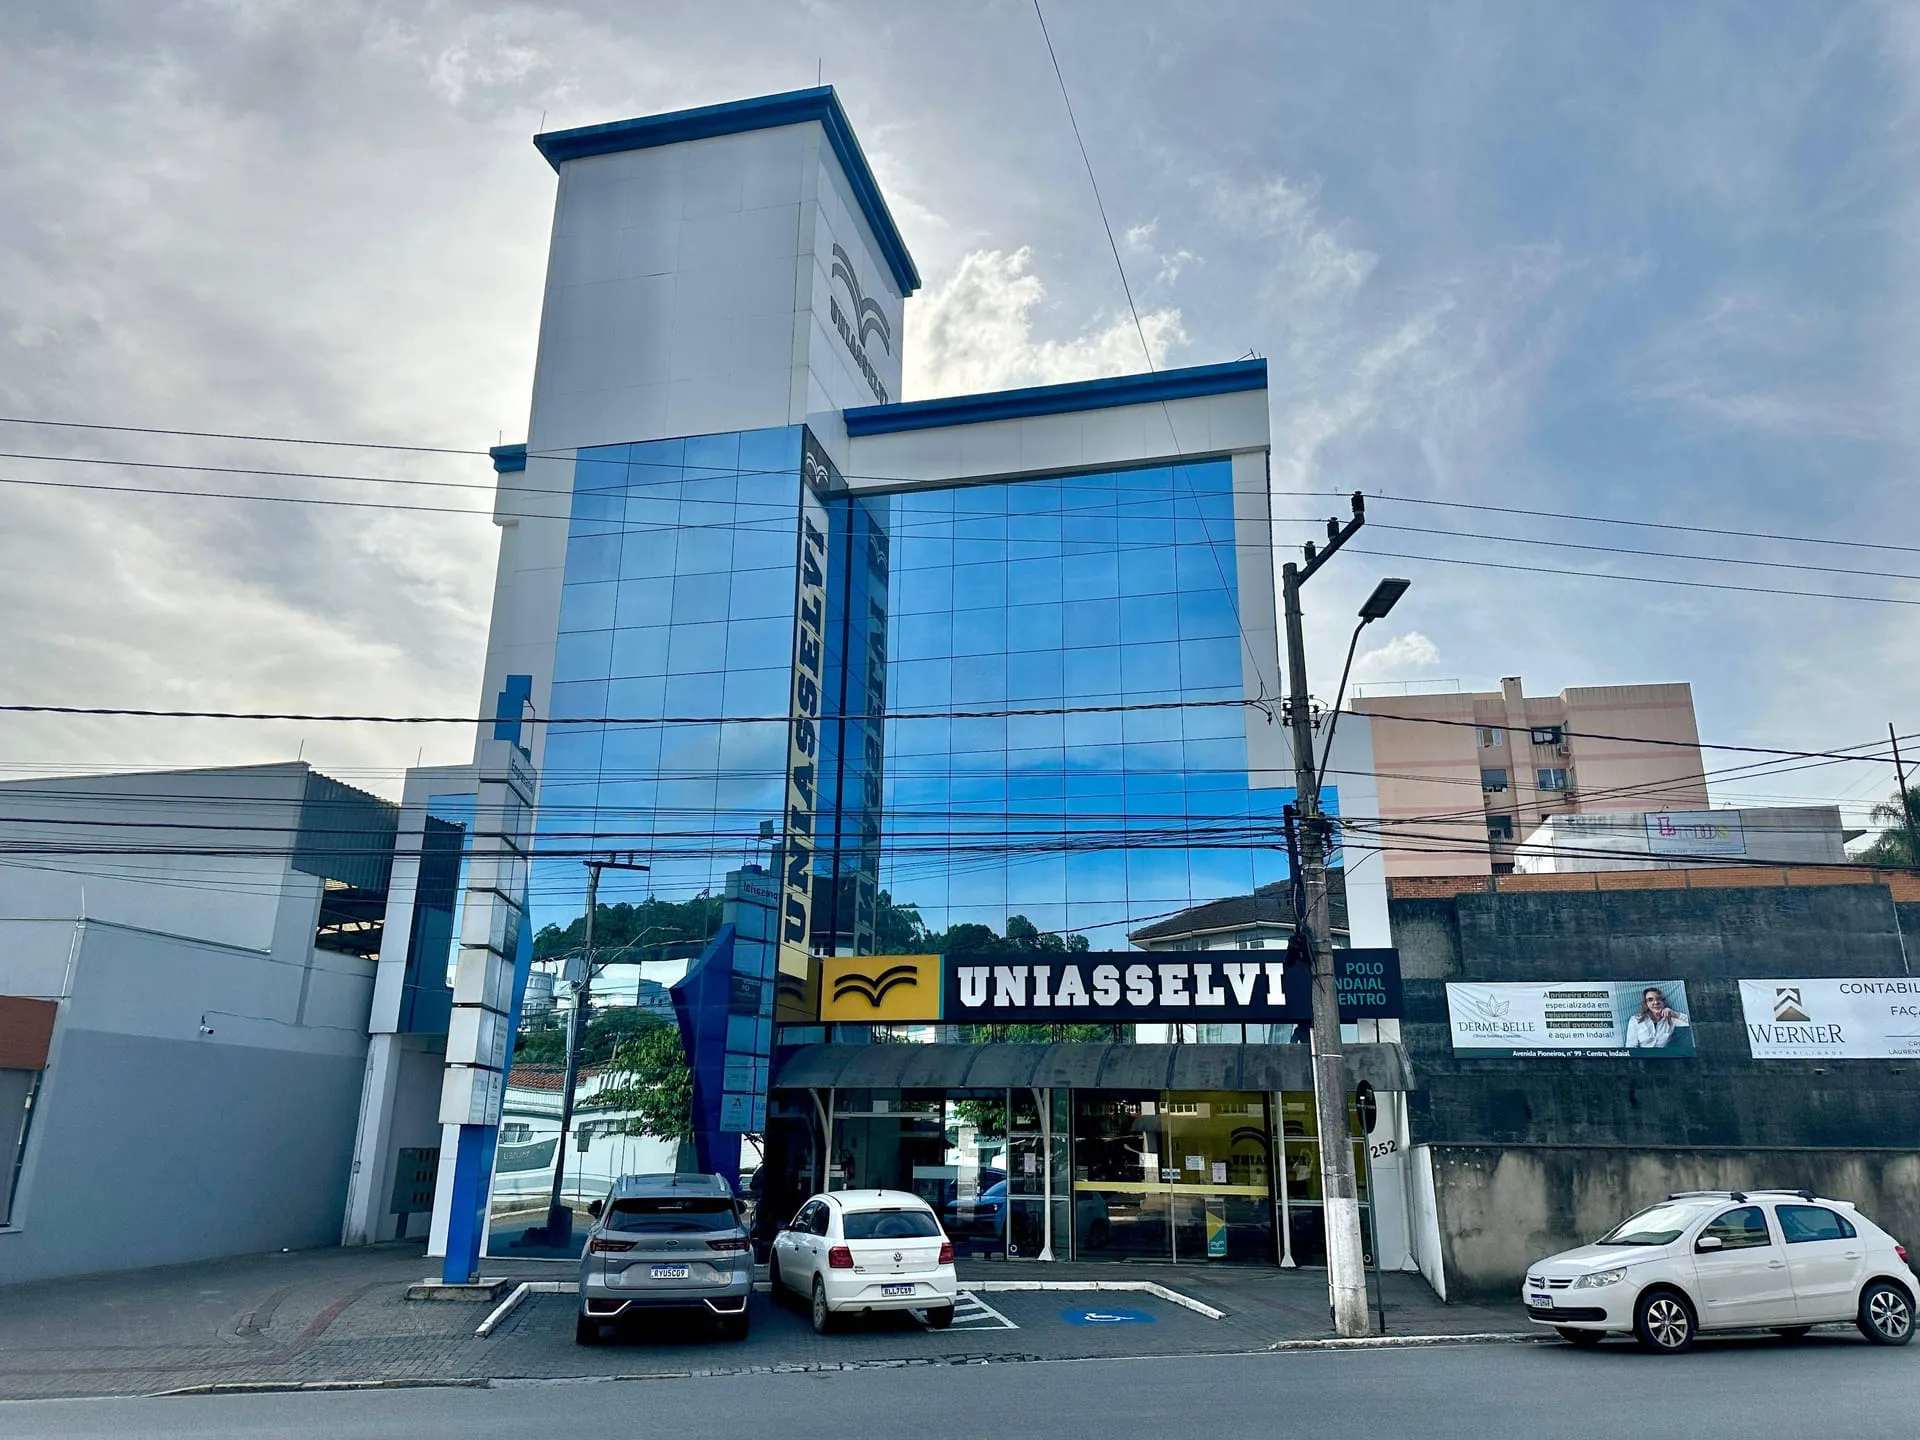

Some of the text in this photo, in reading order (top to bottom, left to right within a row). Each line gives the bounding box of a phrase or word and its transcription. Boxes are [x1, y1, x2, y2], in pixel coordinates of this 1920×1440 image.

[784, 517, 826, 944] UNIASSELVI
[1346, 962, 1384, 975] POLO
[957, 962, 1287, 1007] UNIASSELVI
[1335, 977, 1386, 990] NDAIAL
[1338, 993, 1386, 1005] ENTRO
[1550, 991, 1582, 999] primeira
[1545, 1001, 1596, 1009] especializada
[1890, 1005, 1920, 1018] FAÇ
[1457, 1021, 1536, 1032] DERME BELLE
[1554, 1031, 1571, 1040] aqui
[1748, 1023, 1846, 1044] WERNER
[1586, 1050, 1608, 1058] Centro,
[1370, 1140, 1397, 1159] 252
